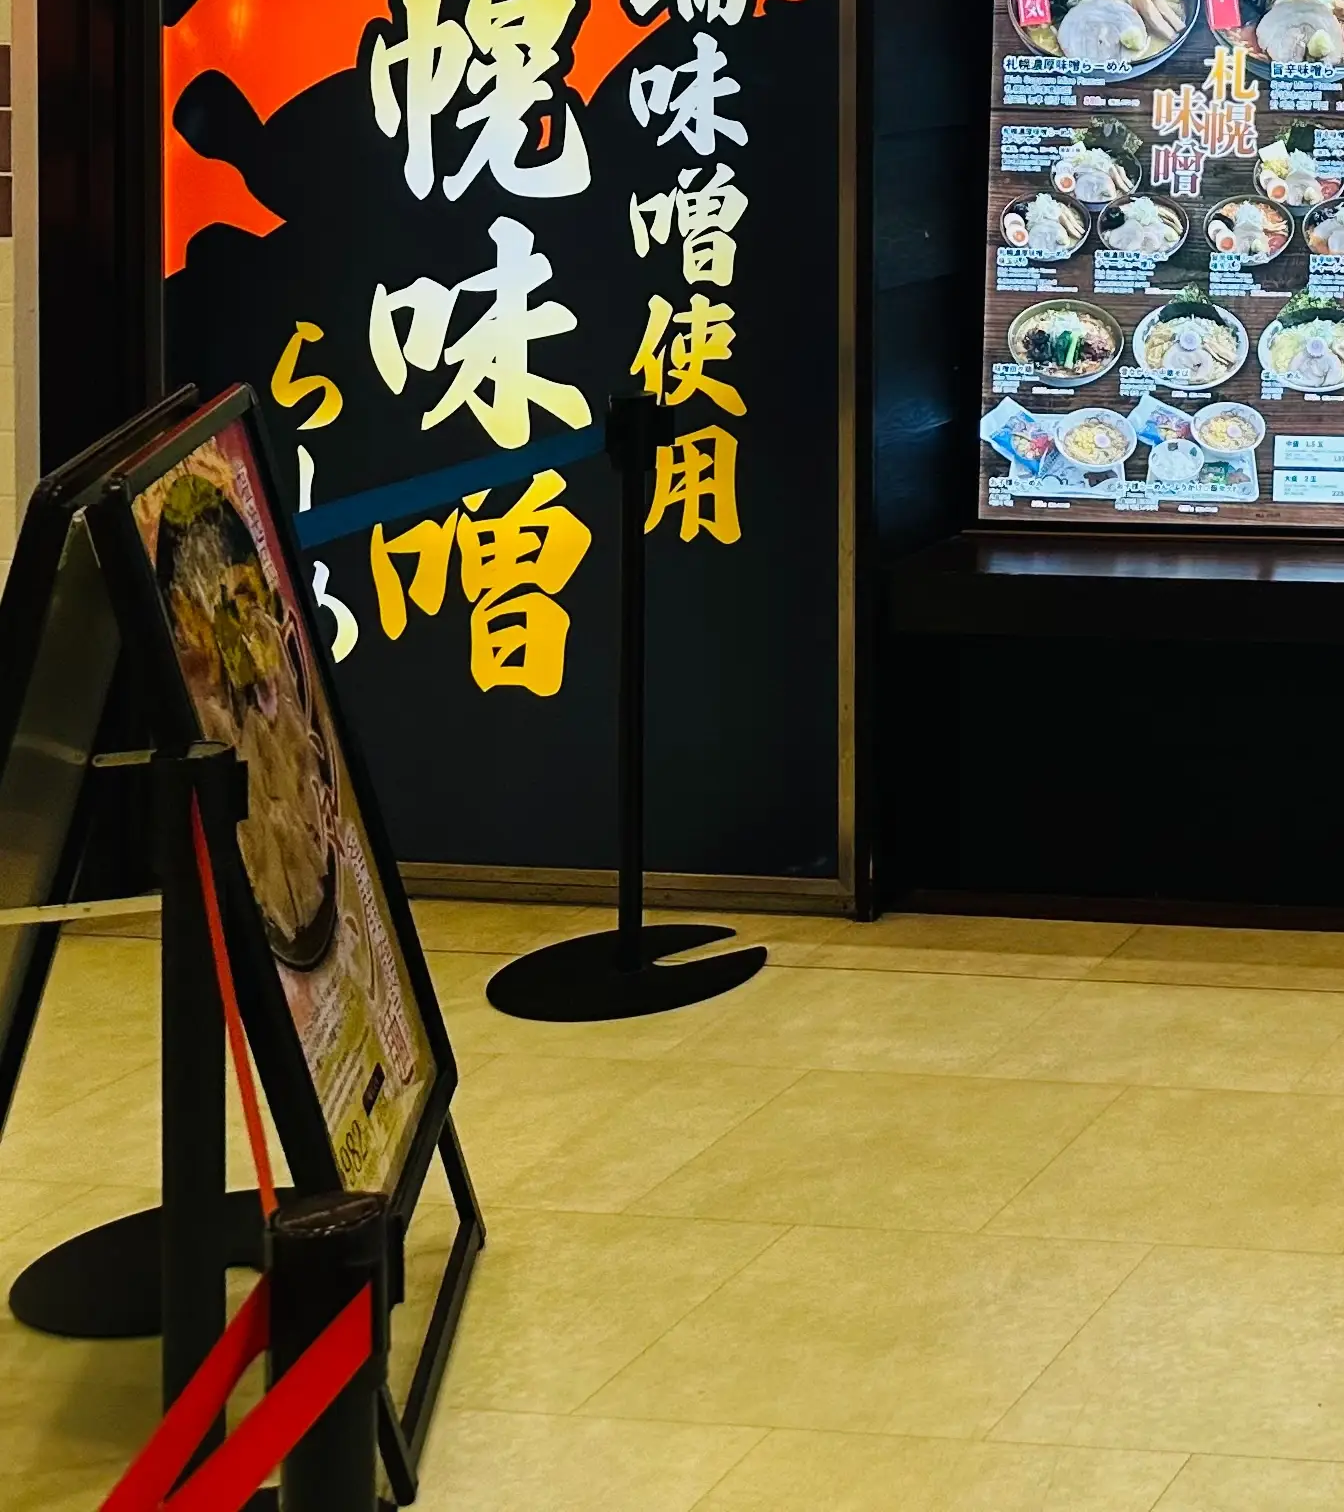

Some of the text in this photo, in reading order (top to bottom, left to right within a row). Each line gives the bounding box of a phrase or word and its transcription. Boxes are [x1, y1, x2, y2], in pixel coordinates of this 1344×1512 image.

[1004, 56, 1133, 73] 札幌濃厚味噌らーめん
[1204, 46, 1261, 159] 札幌
[1151, 85, 1206, 197] 味噌
